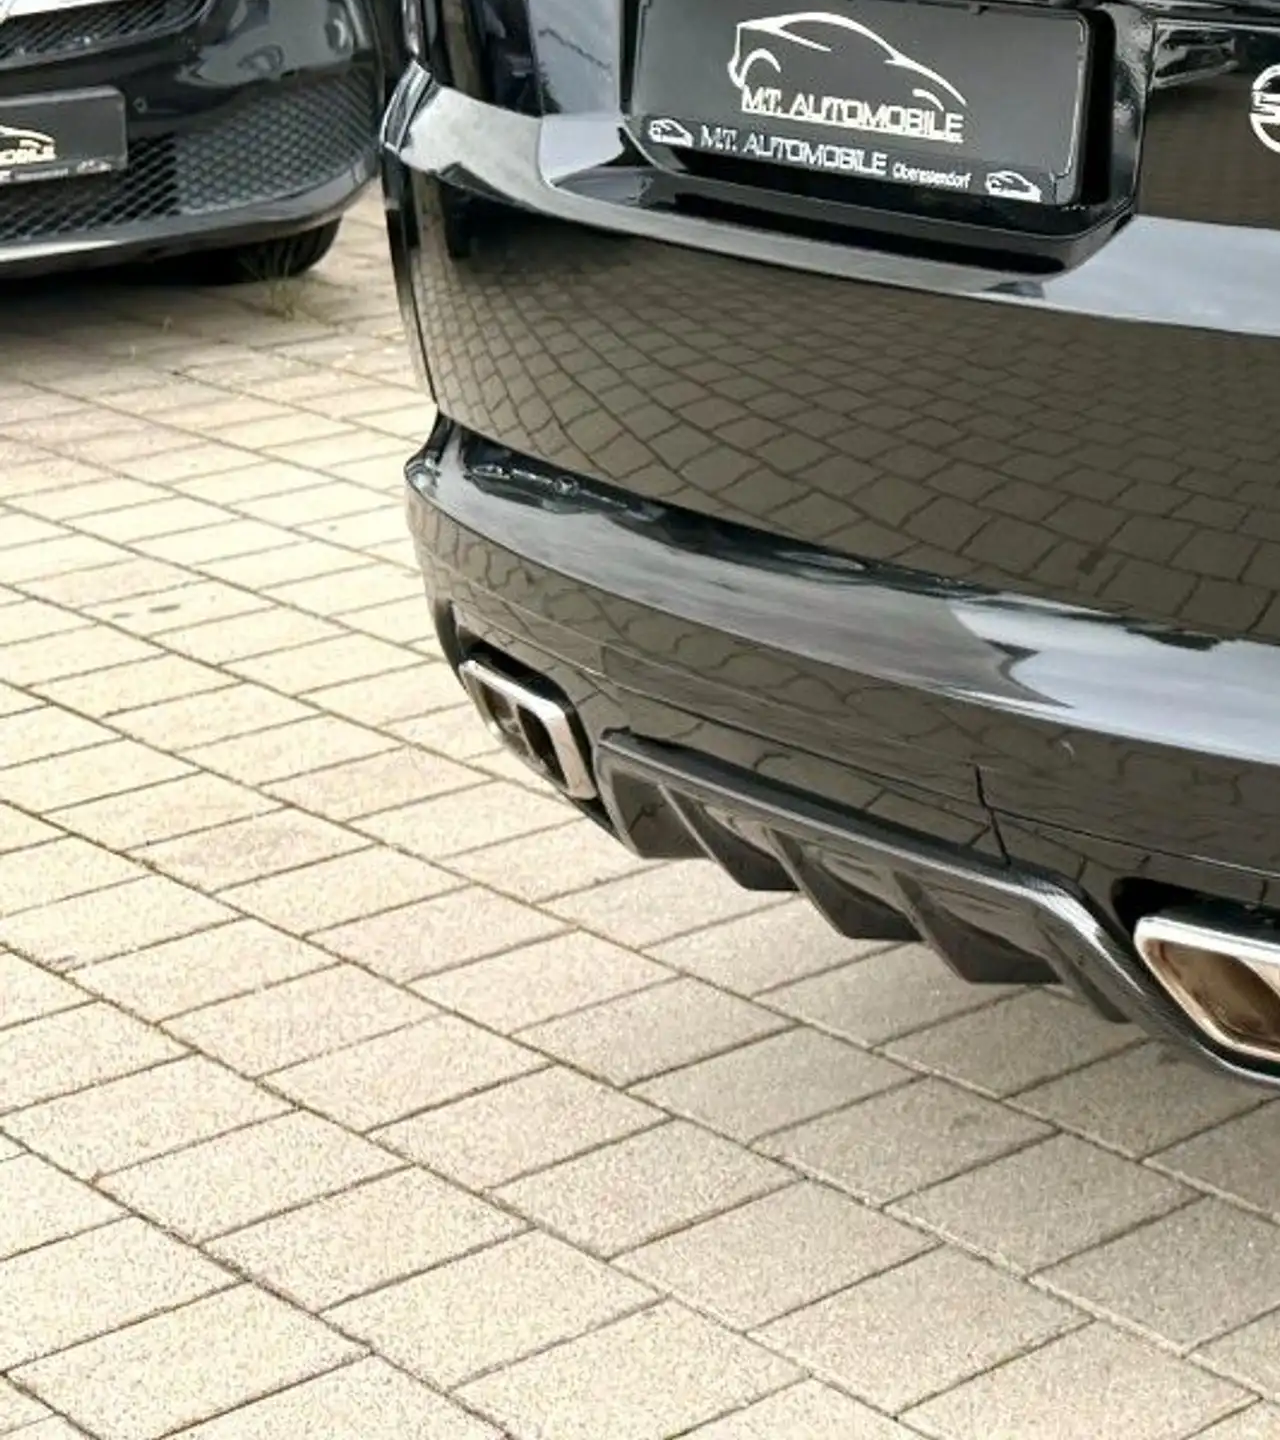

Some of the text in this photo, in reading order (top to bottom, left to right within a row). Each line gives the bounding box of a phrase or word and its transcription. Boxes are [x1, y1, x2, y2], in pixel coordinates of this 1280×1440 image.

[741, 85, 964, 143] M.T. AUTOMOBILE
[700, 124, 738, 152] M.T.
[743, 133, 888, 177] AUTOMOBILE
